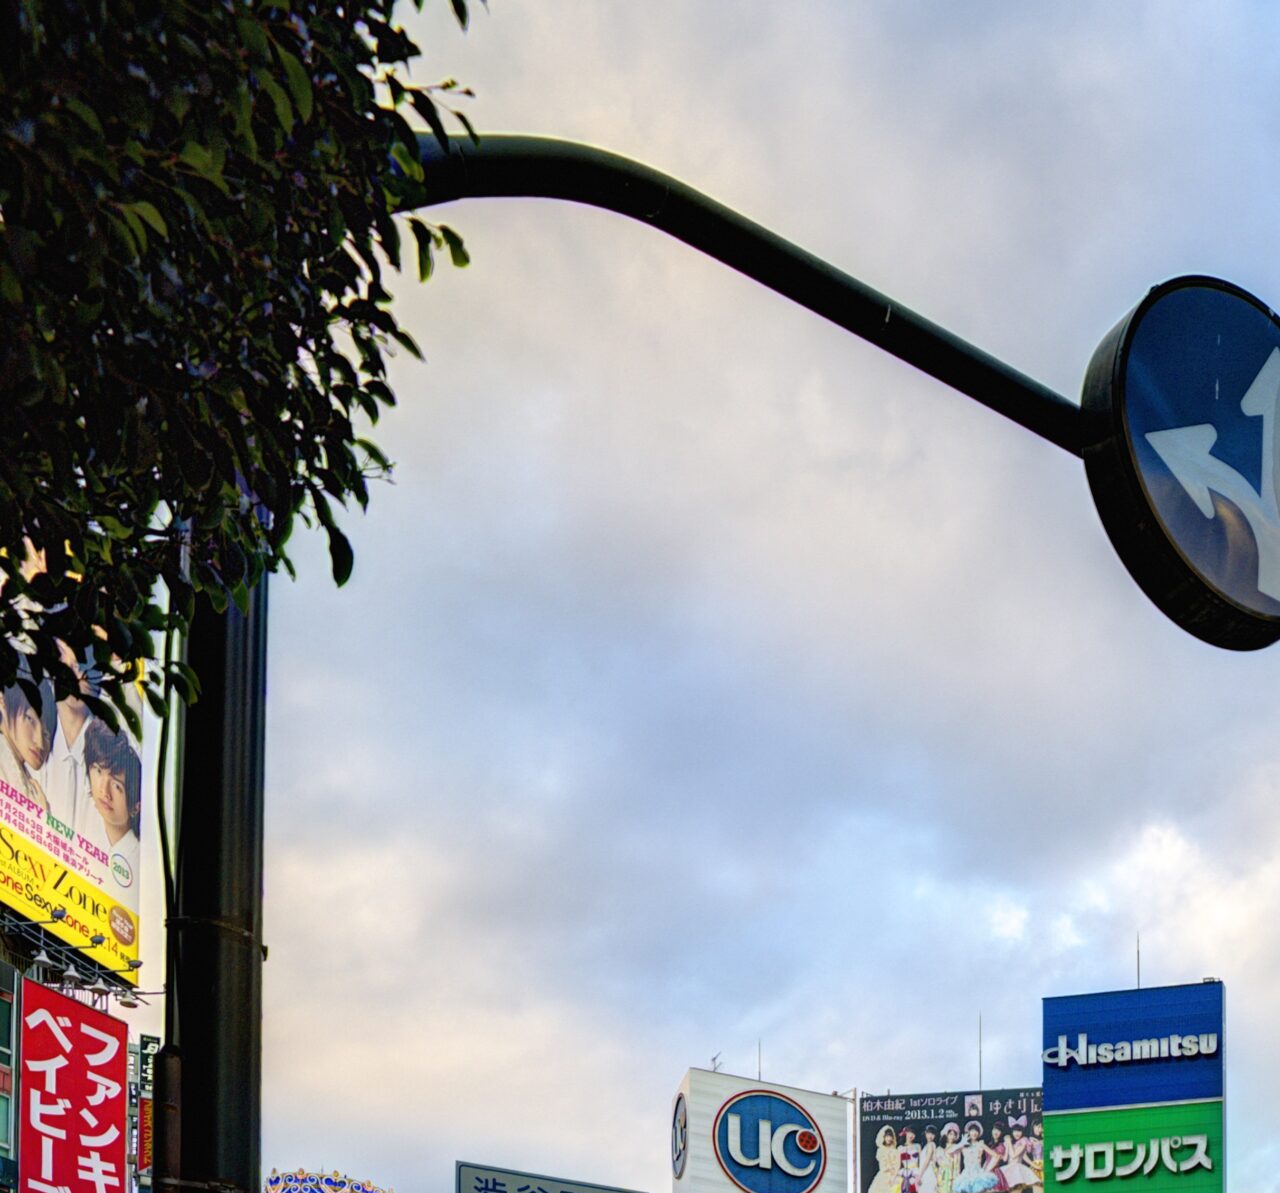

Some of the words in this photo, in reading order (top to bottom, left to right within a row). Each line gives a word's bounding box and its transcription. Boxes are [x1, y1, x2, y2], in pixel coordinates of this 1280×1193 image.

[46, 813, 75, 841] NEW
[77, 834, 110, 867] YEAR
[53, 863, 108, 925] Zone
[1041, 1033, 1217, 1067] Hisamitsu
[1050, 1135, 1211, 1181] サロンパス
